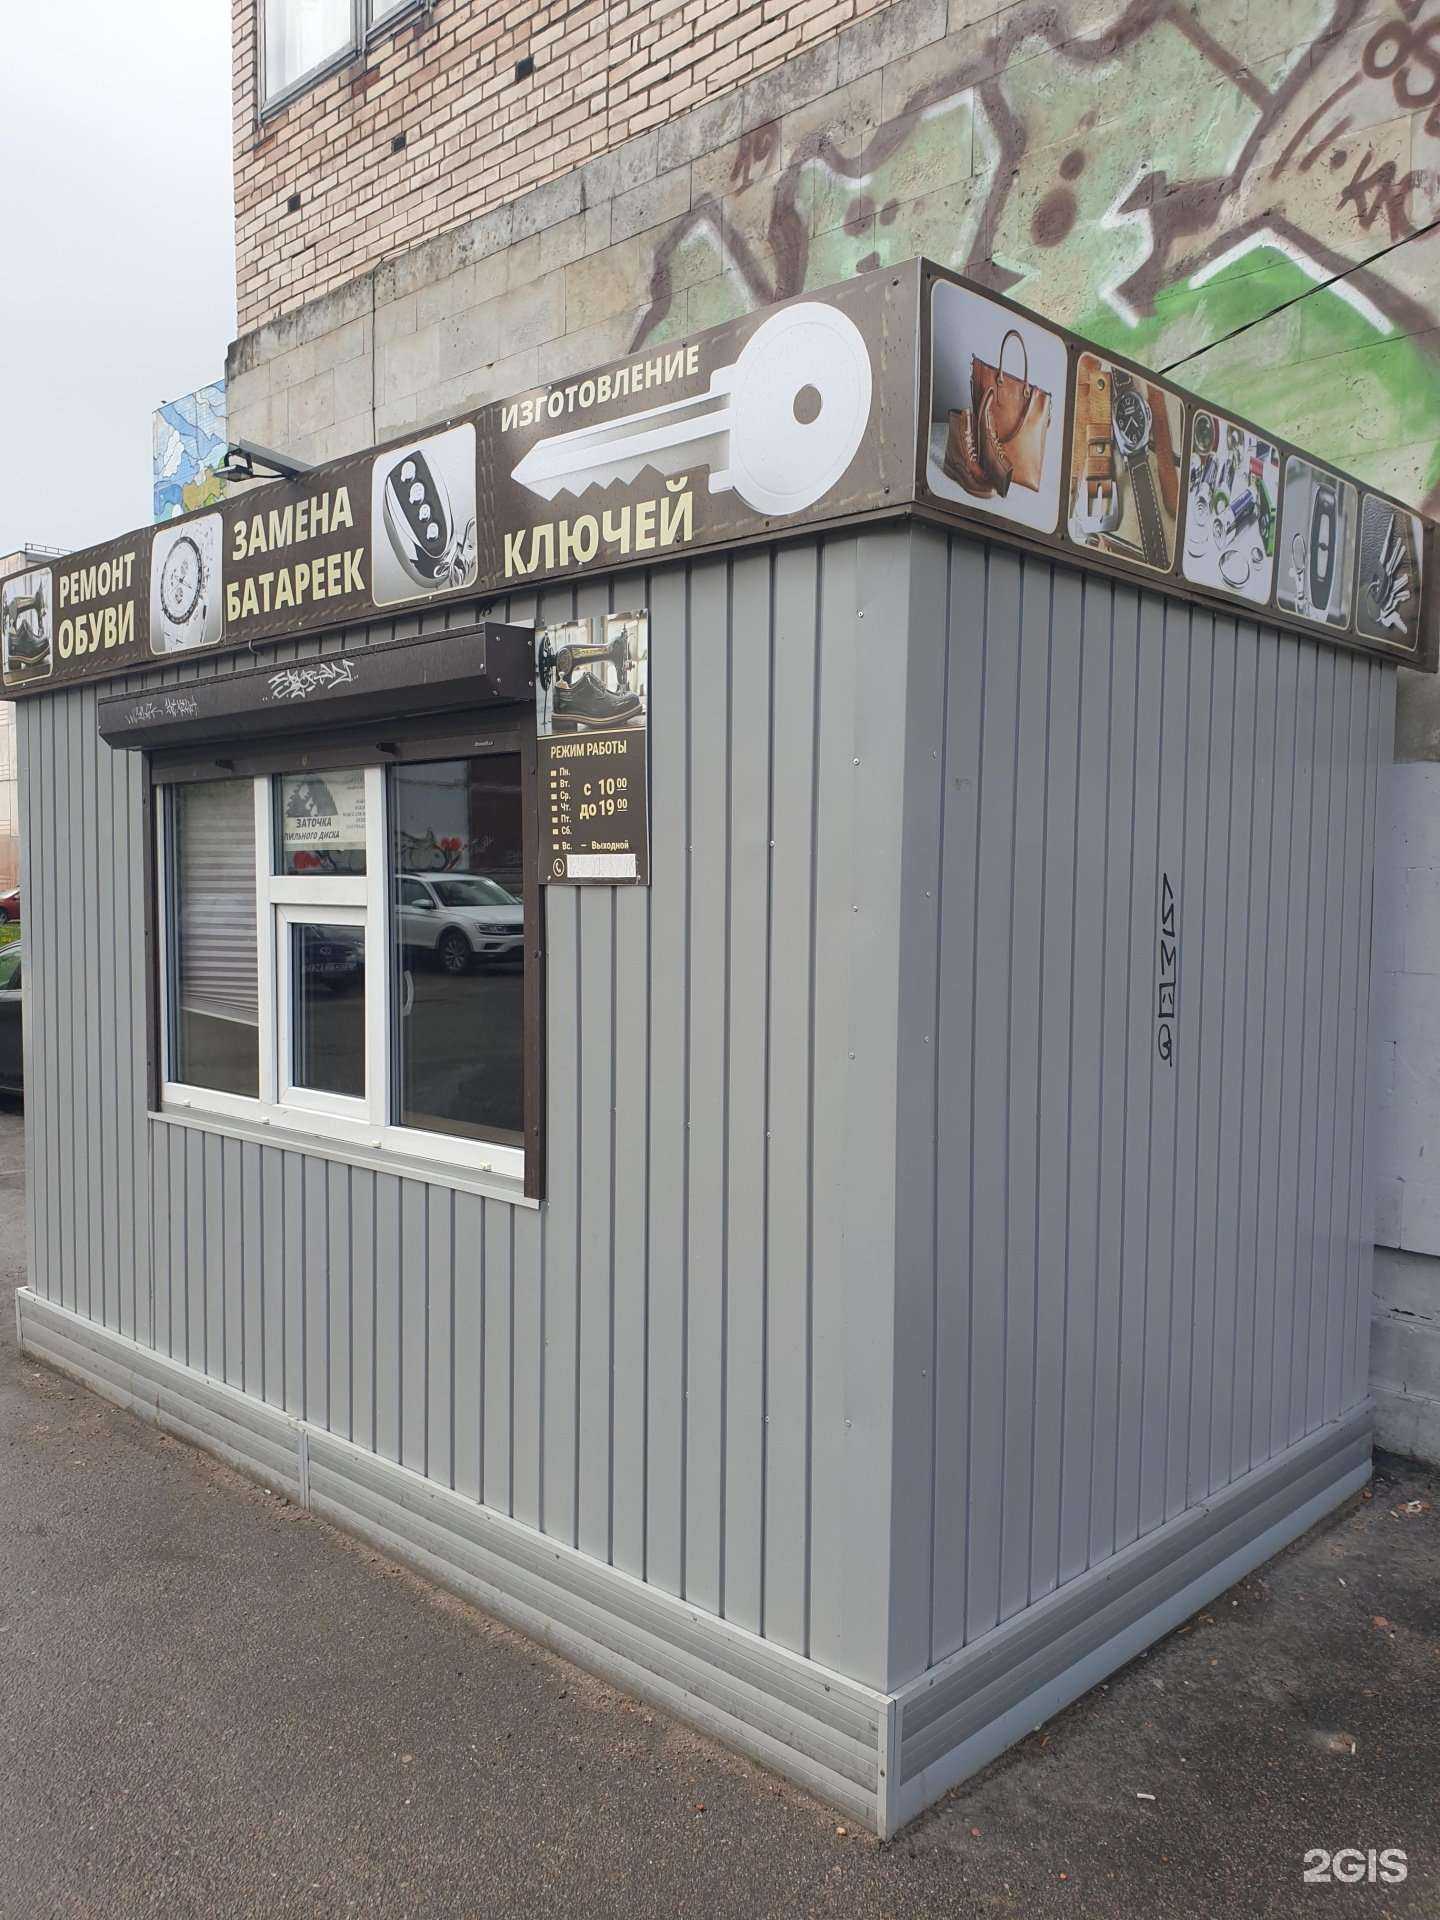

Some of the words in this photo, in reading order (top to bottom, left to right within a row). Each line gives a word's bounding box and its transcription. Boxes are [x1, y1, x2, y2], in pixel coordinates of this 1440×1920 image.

[501, 345, 699, 432] ИЗГОТОВЛЕНИЕ
[232, 486, 354, 561] ЗАМЕНА
[504, 476, 693, 577] КЛЮЧЕЙ
[59, 552, 136, 609] РЕМОНТ
[226, 547, 366, 622] БАТАРЕЕК
[58, 600, 135, 660] ОБУВИ
[550, 743, 585, 759] РЕЖИМ
[586, 740, 627, 756] РАБОТЫ
[295, 817, 332, 828] ЗАТОЧКА
[318, 831, 340, 841] ДИСКА
[579, 803, 597, 820] до
[591, 840, 629, 851] Выходной
